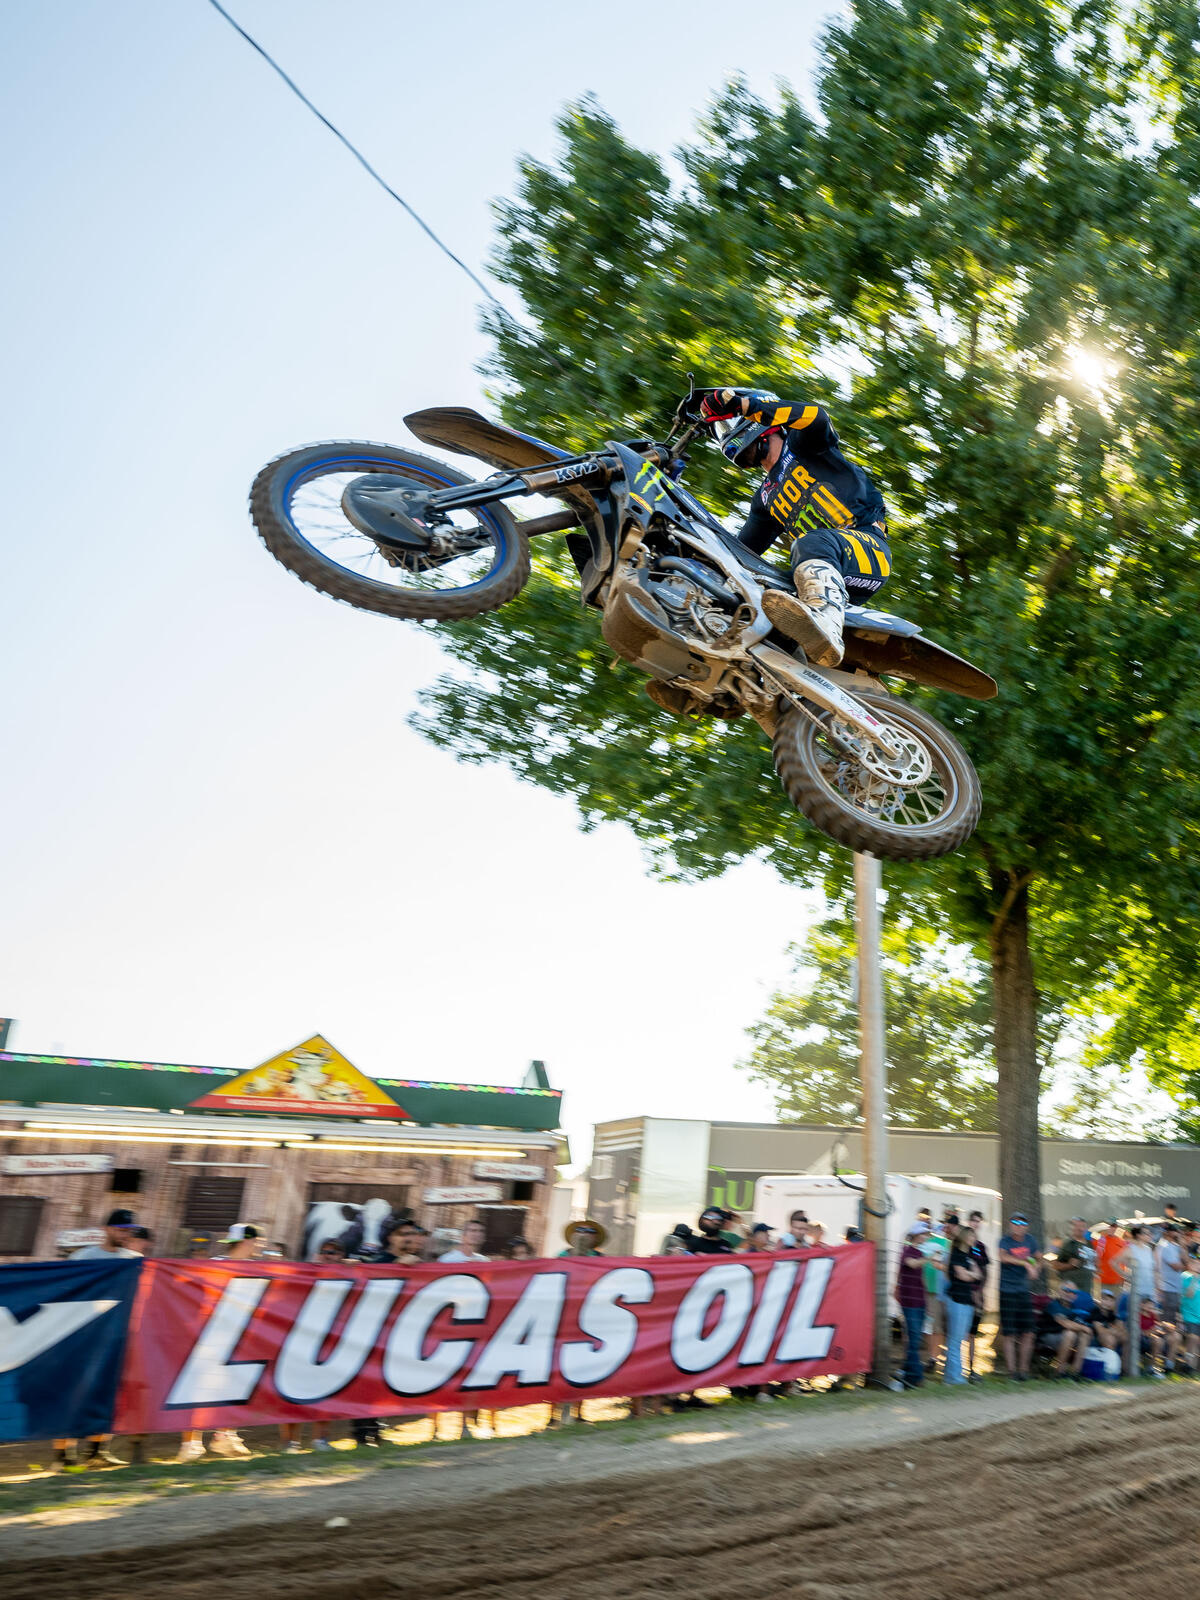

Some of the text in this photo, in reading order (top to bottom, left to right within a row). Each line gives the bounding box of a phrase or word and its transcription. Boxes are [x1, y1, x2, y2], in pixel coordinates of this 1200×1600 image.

[769, 465, 816, 527] THOR
[802, 670, 836, 692] YAMALUBE
[1058, 1158, 1163, 1178] State Of The Art
[1143, 1181, 1191, 1201] System
[165, 1267, 656, 1410] LUCAS
[670, 1256, 838, 1376] OIL
